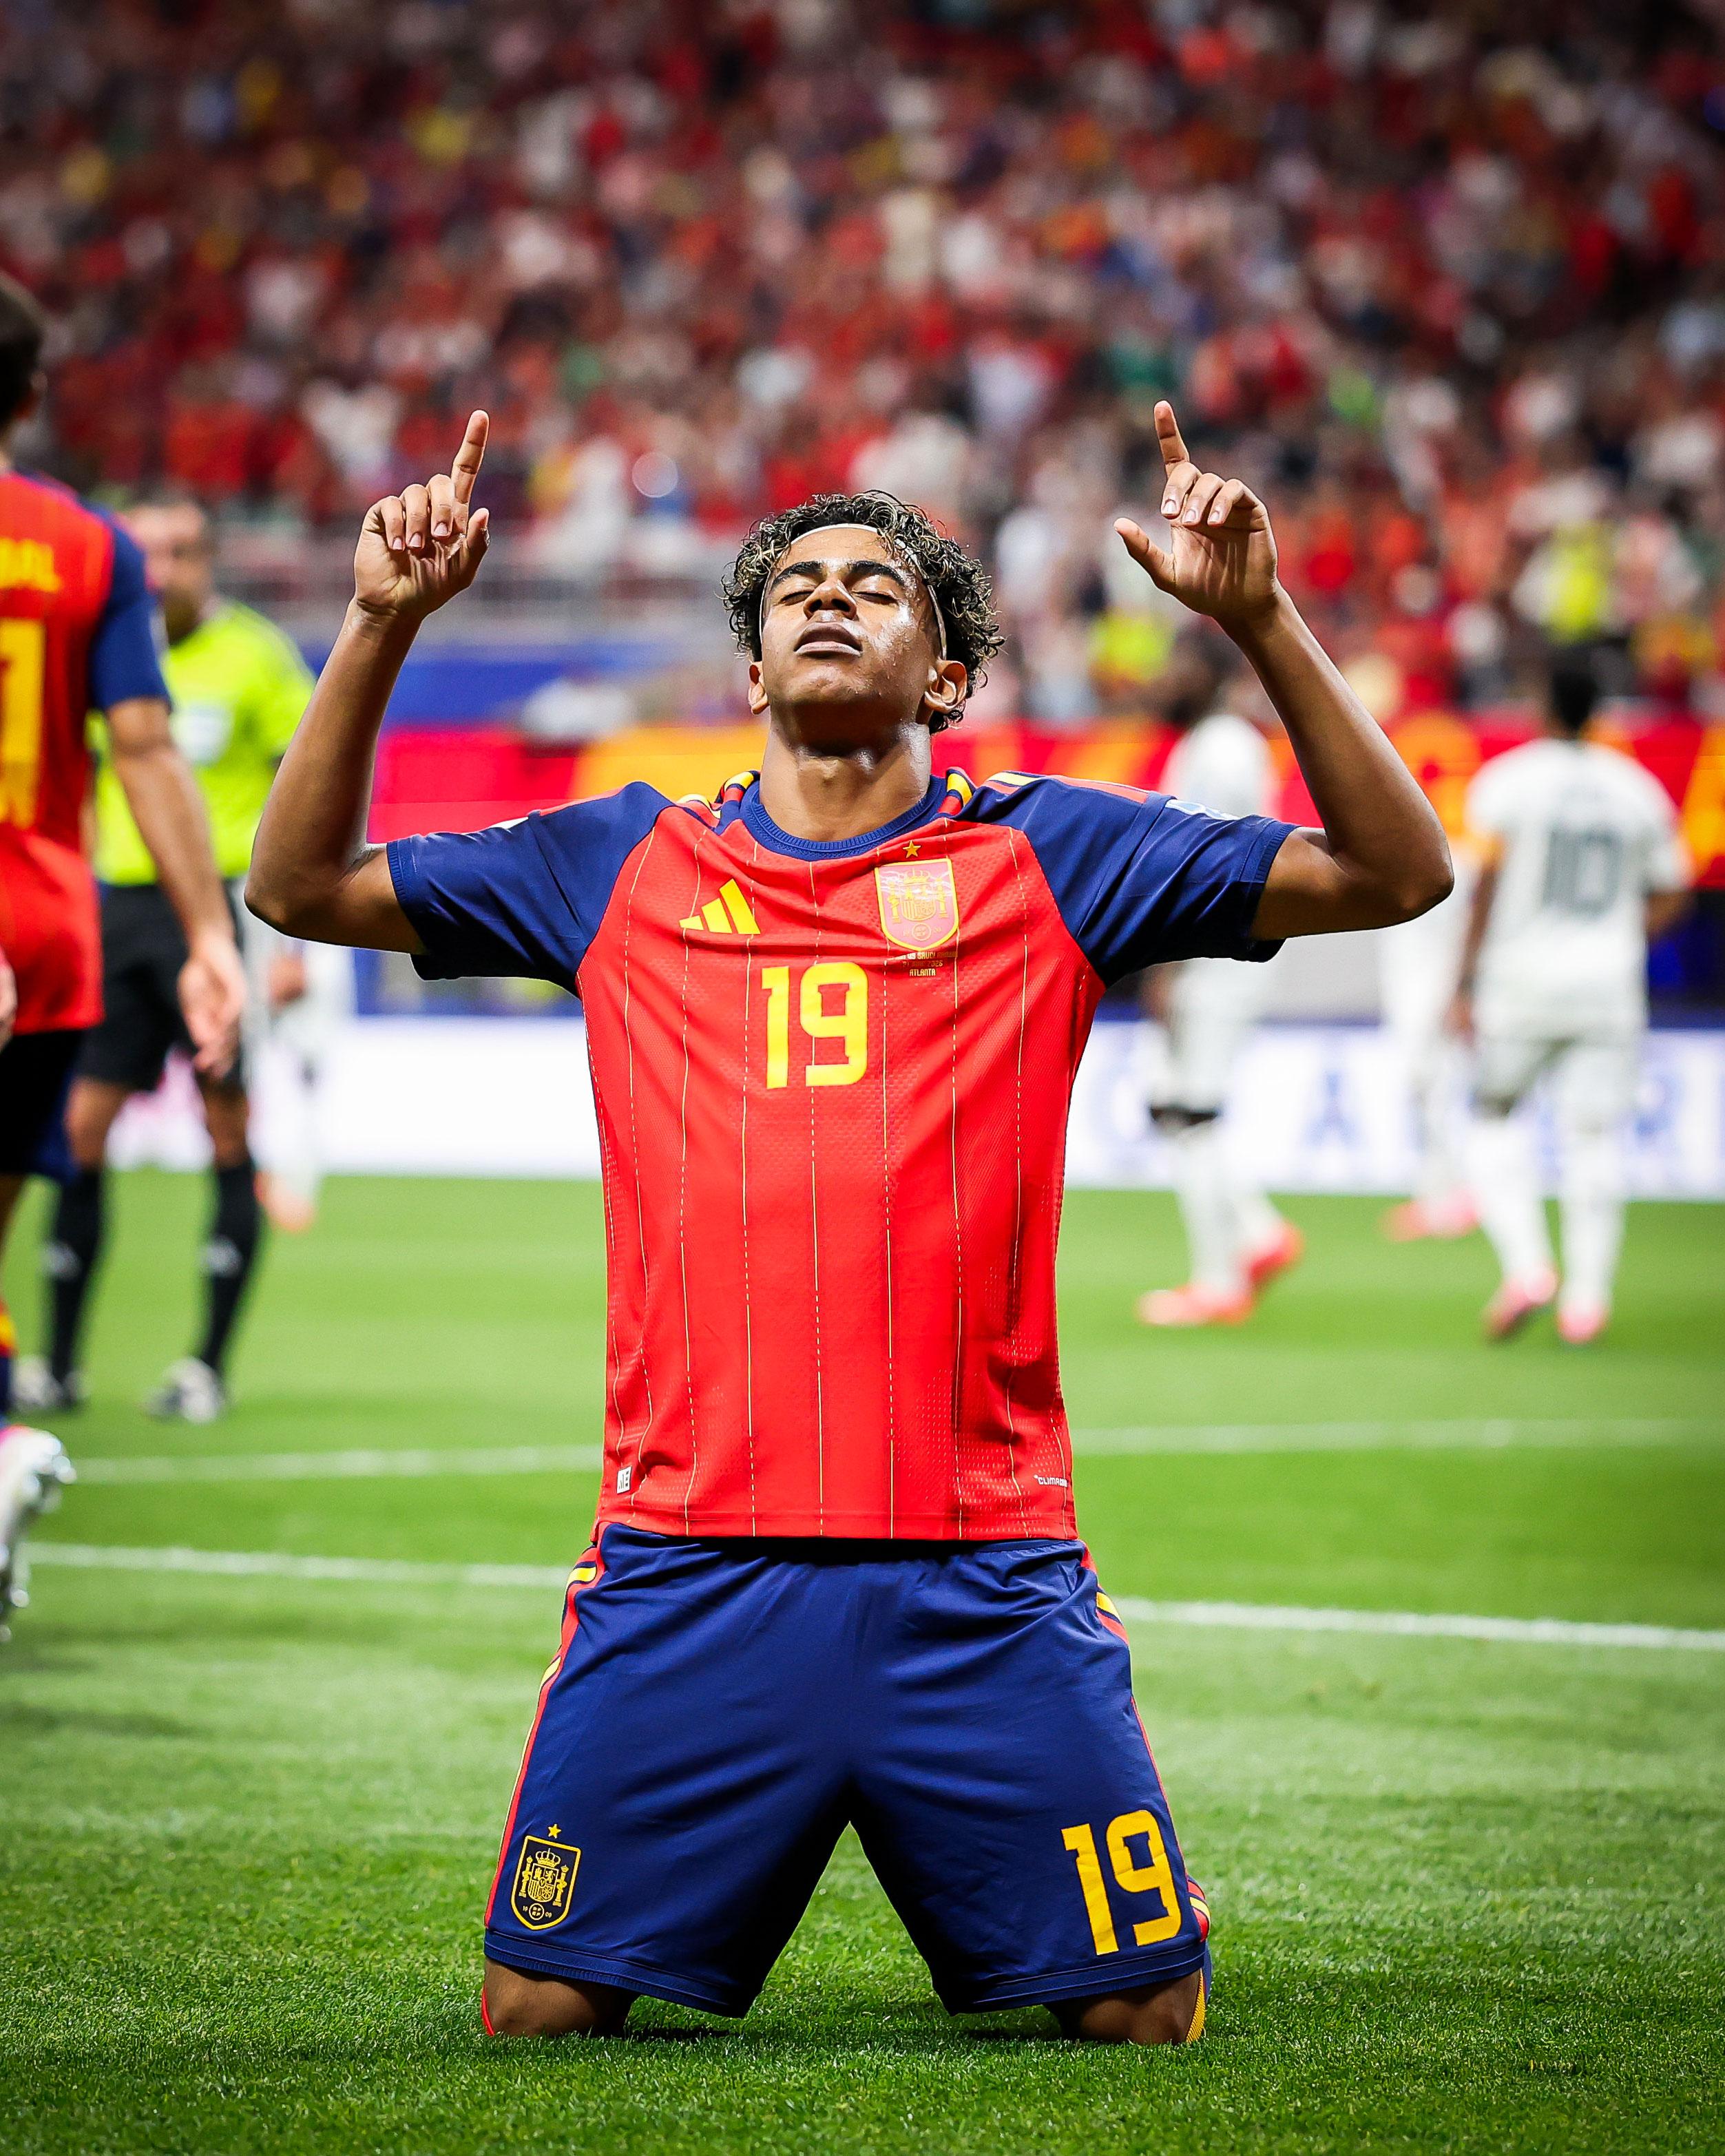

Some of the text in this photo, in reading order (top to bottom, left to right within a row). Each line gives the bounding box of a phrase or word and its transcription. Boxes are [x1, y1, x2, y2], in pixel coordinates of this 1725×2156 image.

[1543, 826, 1623, 919] 10
[761, 961, 868, 1089] 19
[909, 968, 936, 976] ATLANTA
[1061, 1810, 1182, 1956] 19
